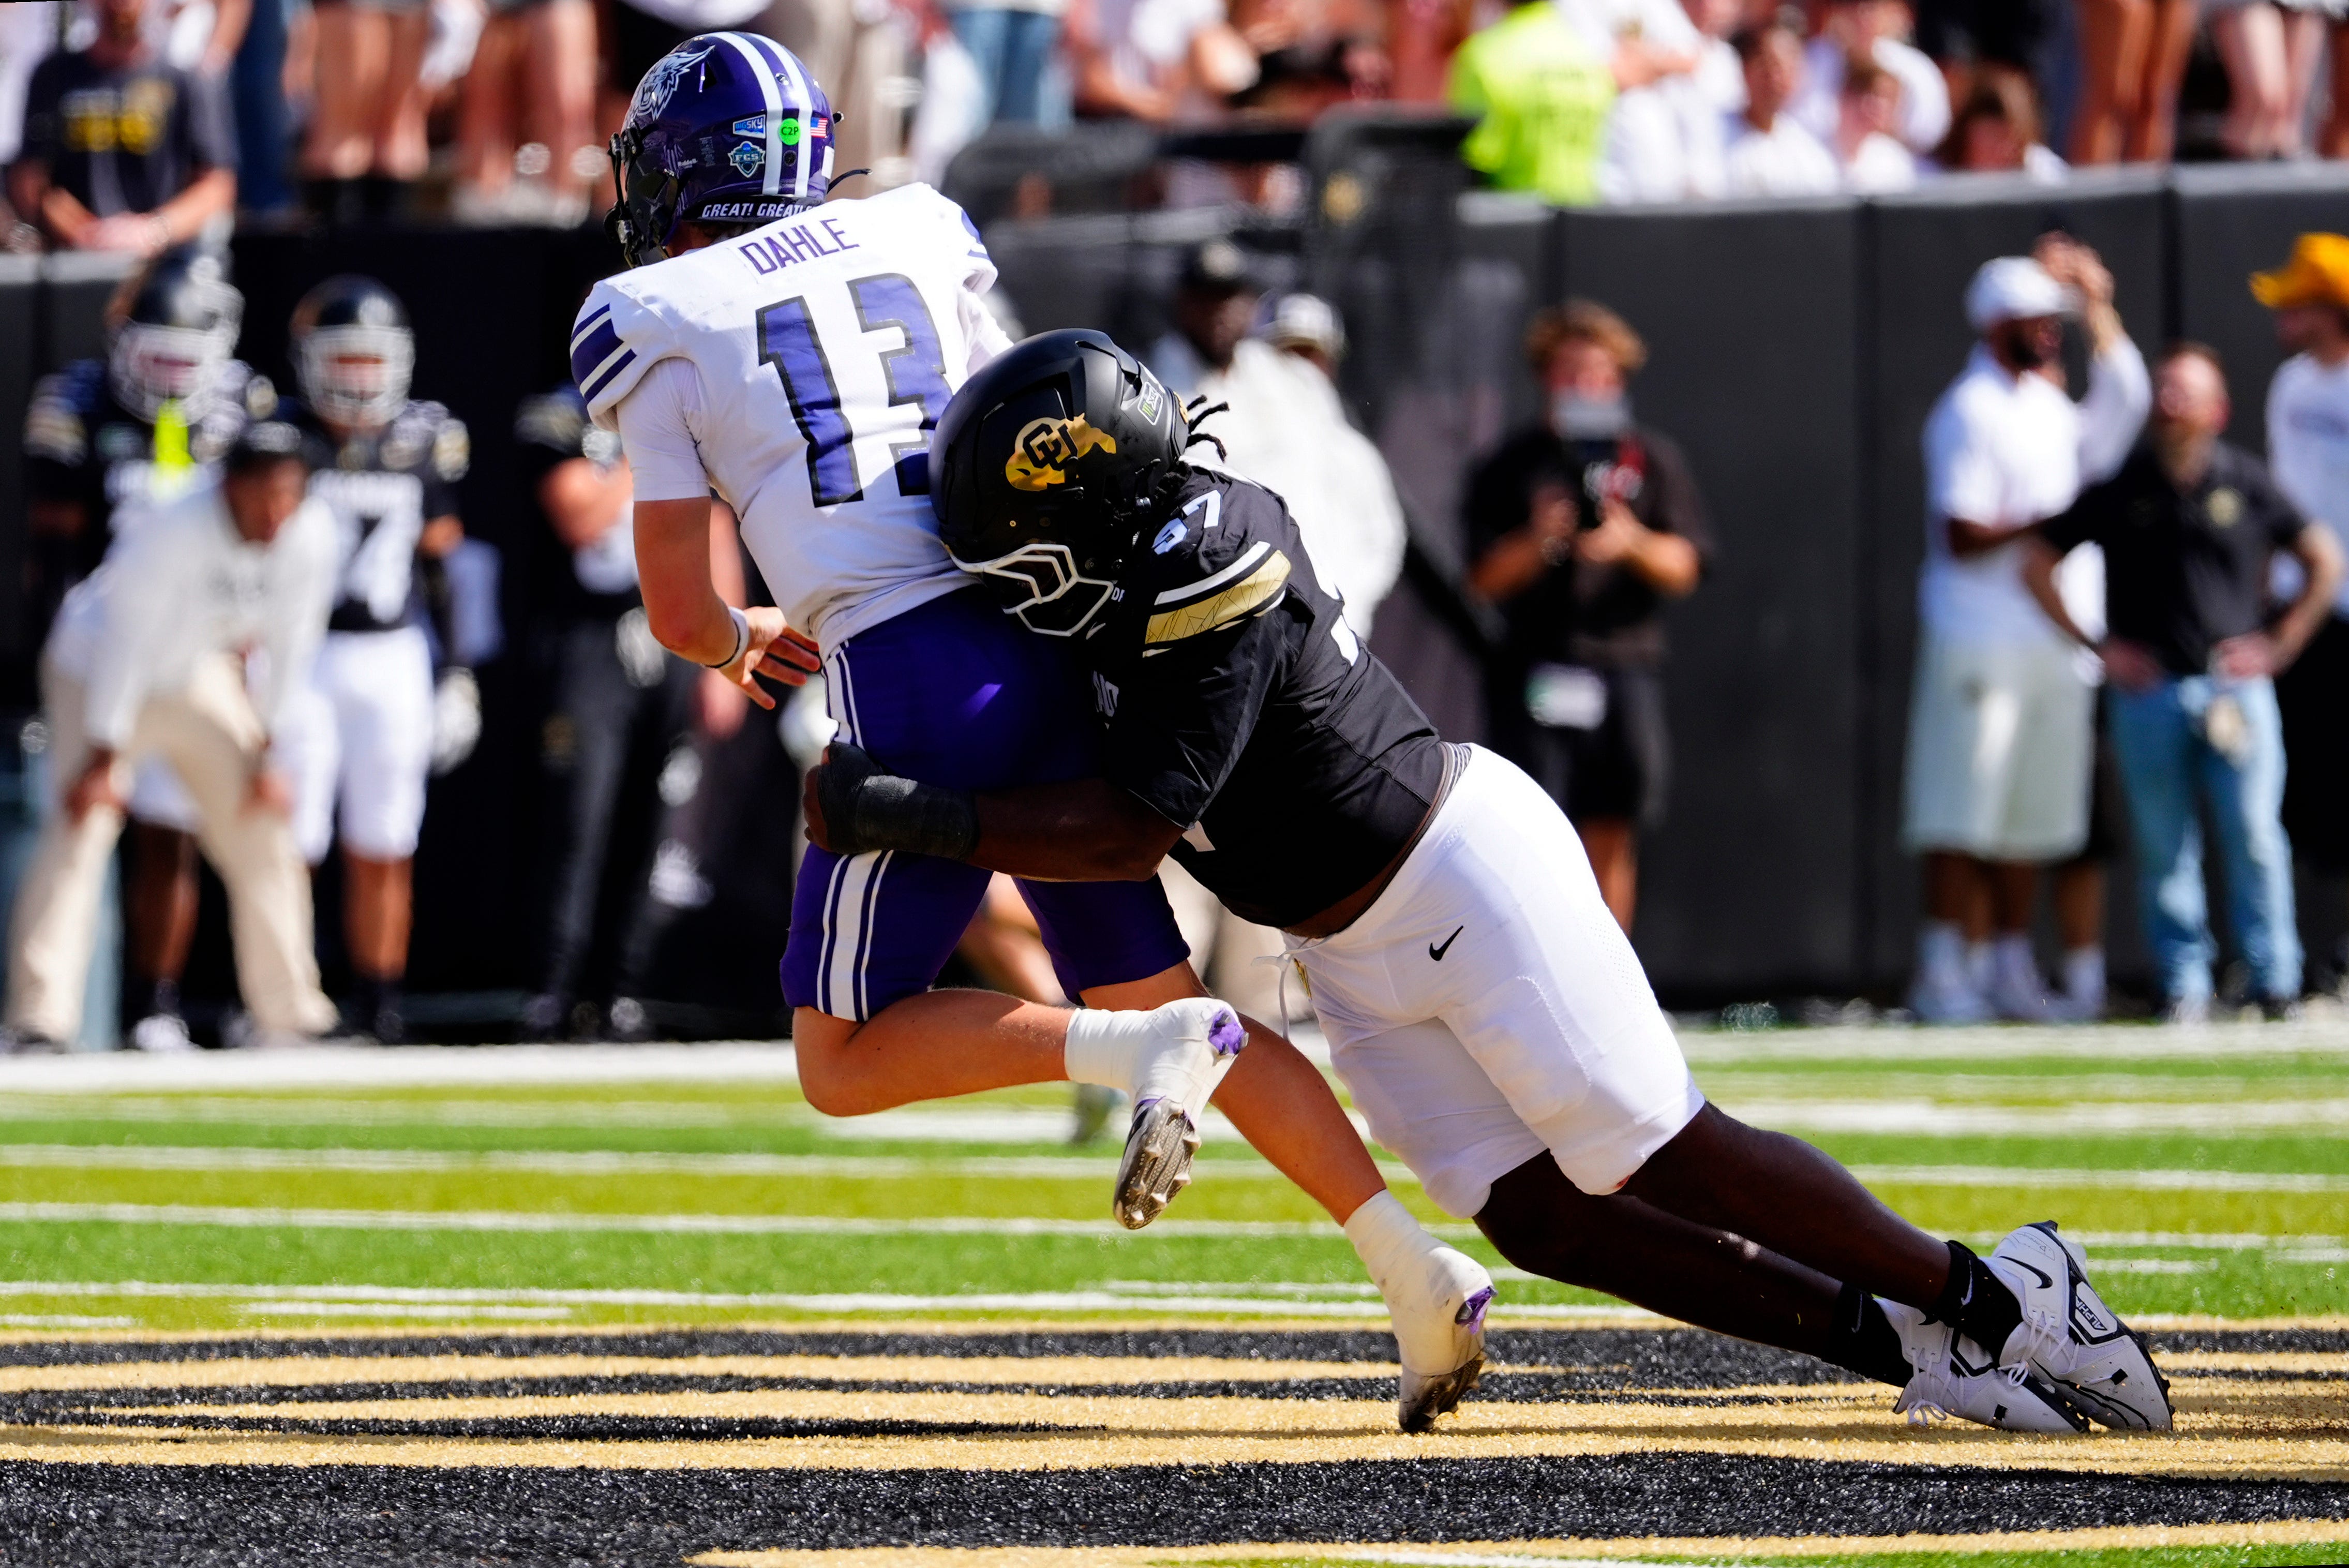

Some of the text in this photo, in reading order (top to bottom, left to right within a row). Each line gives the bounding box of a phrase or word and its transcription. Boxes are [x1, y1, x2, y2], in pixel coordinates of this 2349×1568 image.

[781, 127, 799, 136] C2P
[701, 203, 753, 218] GREAT!
[738, 218, 860, 275] DAHLE
[755, 273, 952, 508] 13
[2076, 1296, 2105, 1330] ALPHA
